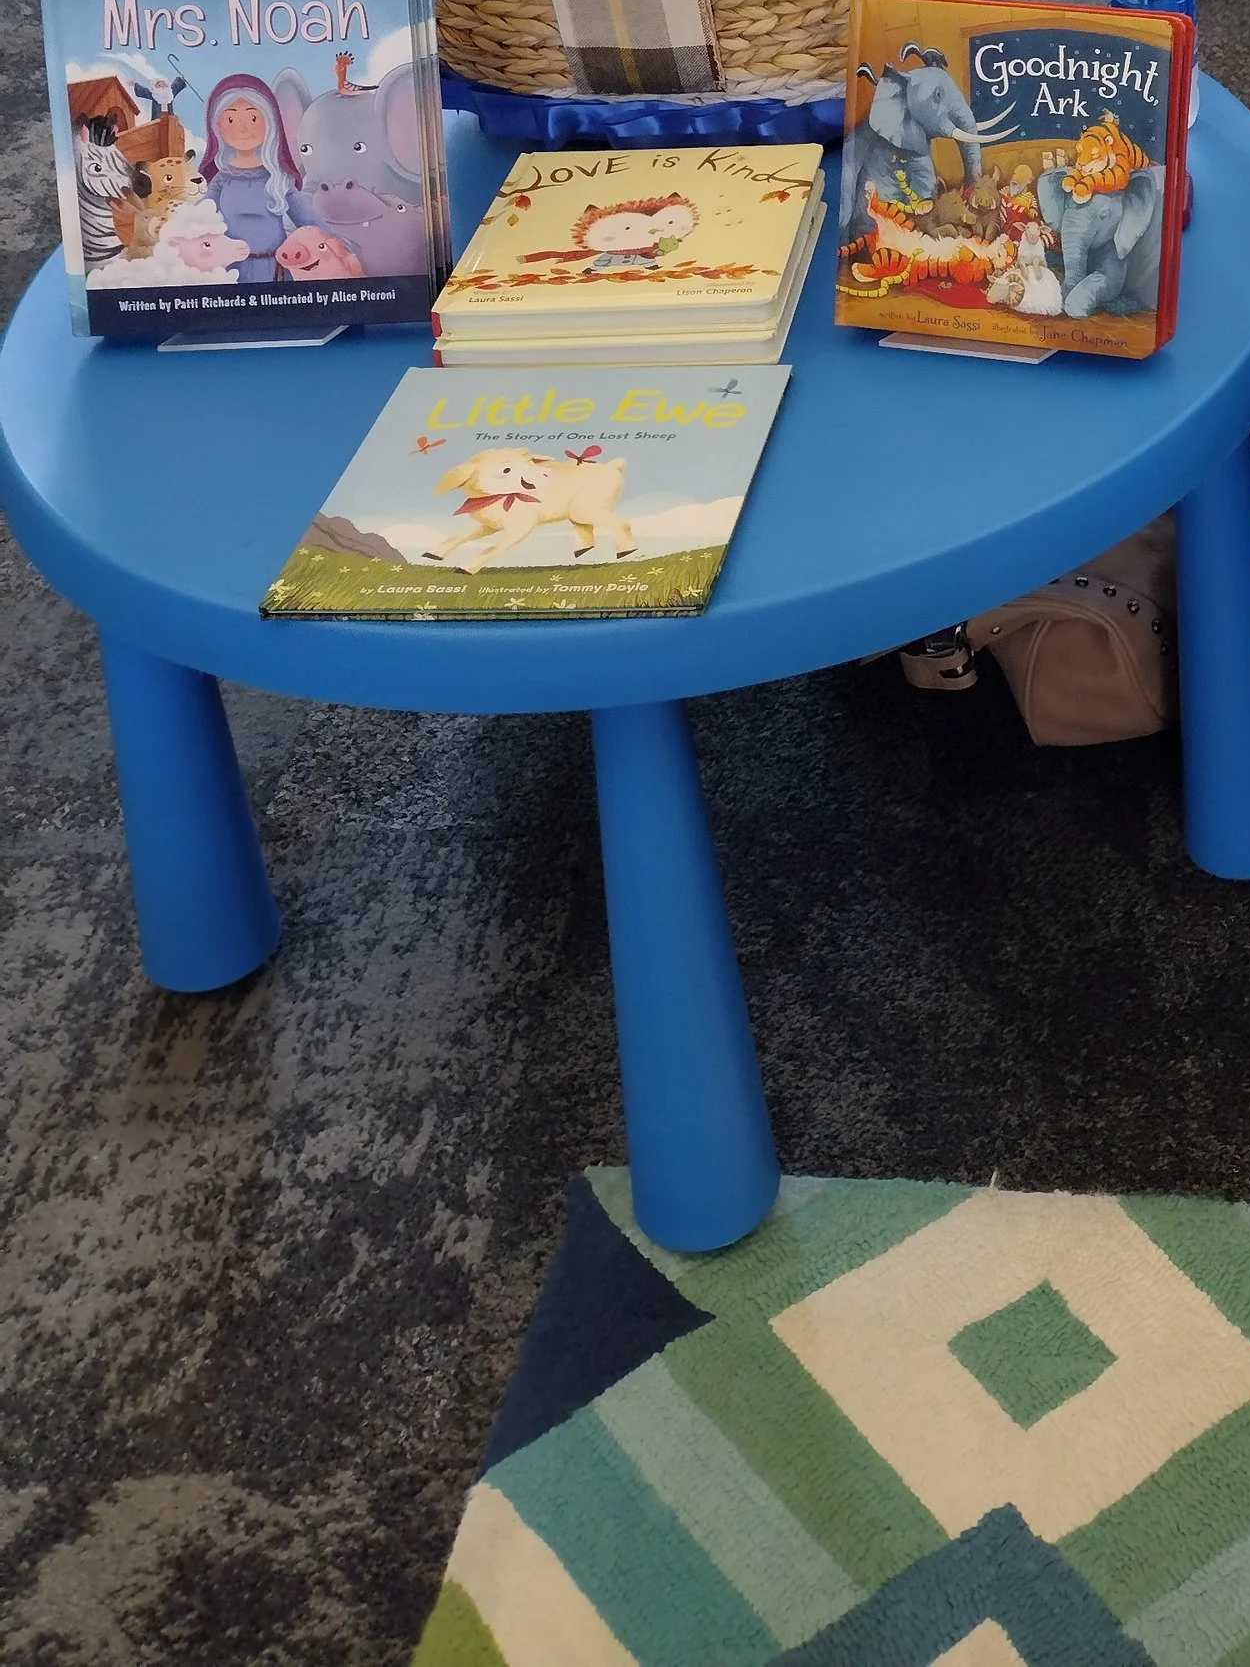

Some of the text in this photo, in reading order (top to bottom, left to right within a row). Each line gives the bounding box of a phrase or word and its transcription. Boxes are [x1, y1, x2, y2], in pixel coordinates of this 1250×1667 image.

[974, 42, 1160, 107] Goodnight,
[1030, 82, 1089, 118] Ark
[528, 148, 800, 187] LOVE is Kind
[119, 289, 396, 313] Written by Patti Richards & Illustrated by Alice Pieroni
[705, 286, 753, 296] Chaperon
[916, 310, 950, 327] Laura
[952, 315, 981, 332] Sassi
[1071, 330, 1129, 348] Chapman
[426, 387, 747, 431] Little Ewe
[475, 432, 677, 442] The Story of One Lost Sheep
[376, 585, 422, 594] Laura
[426, 584, 468, 594] Sassi
[478, 586, 533, 594] illustrated
[535, 586, 550, 595] by
[552, 584, 603, 595] Tommy
[606, 583, 649, 594] Doyle
